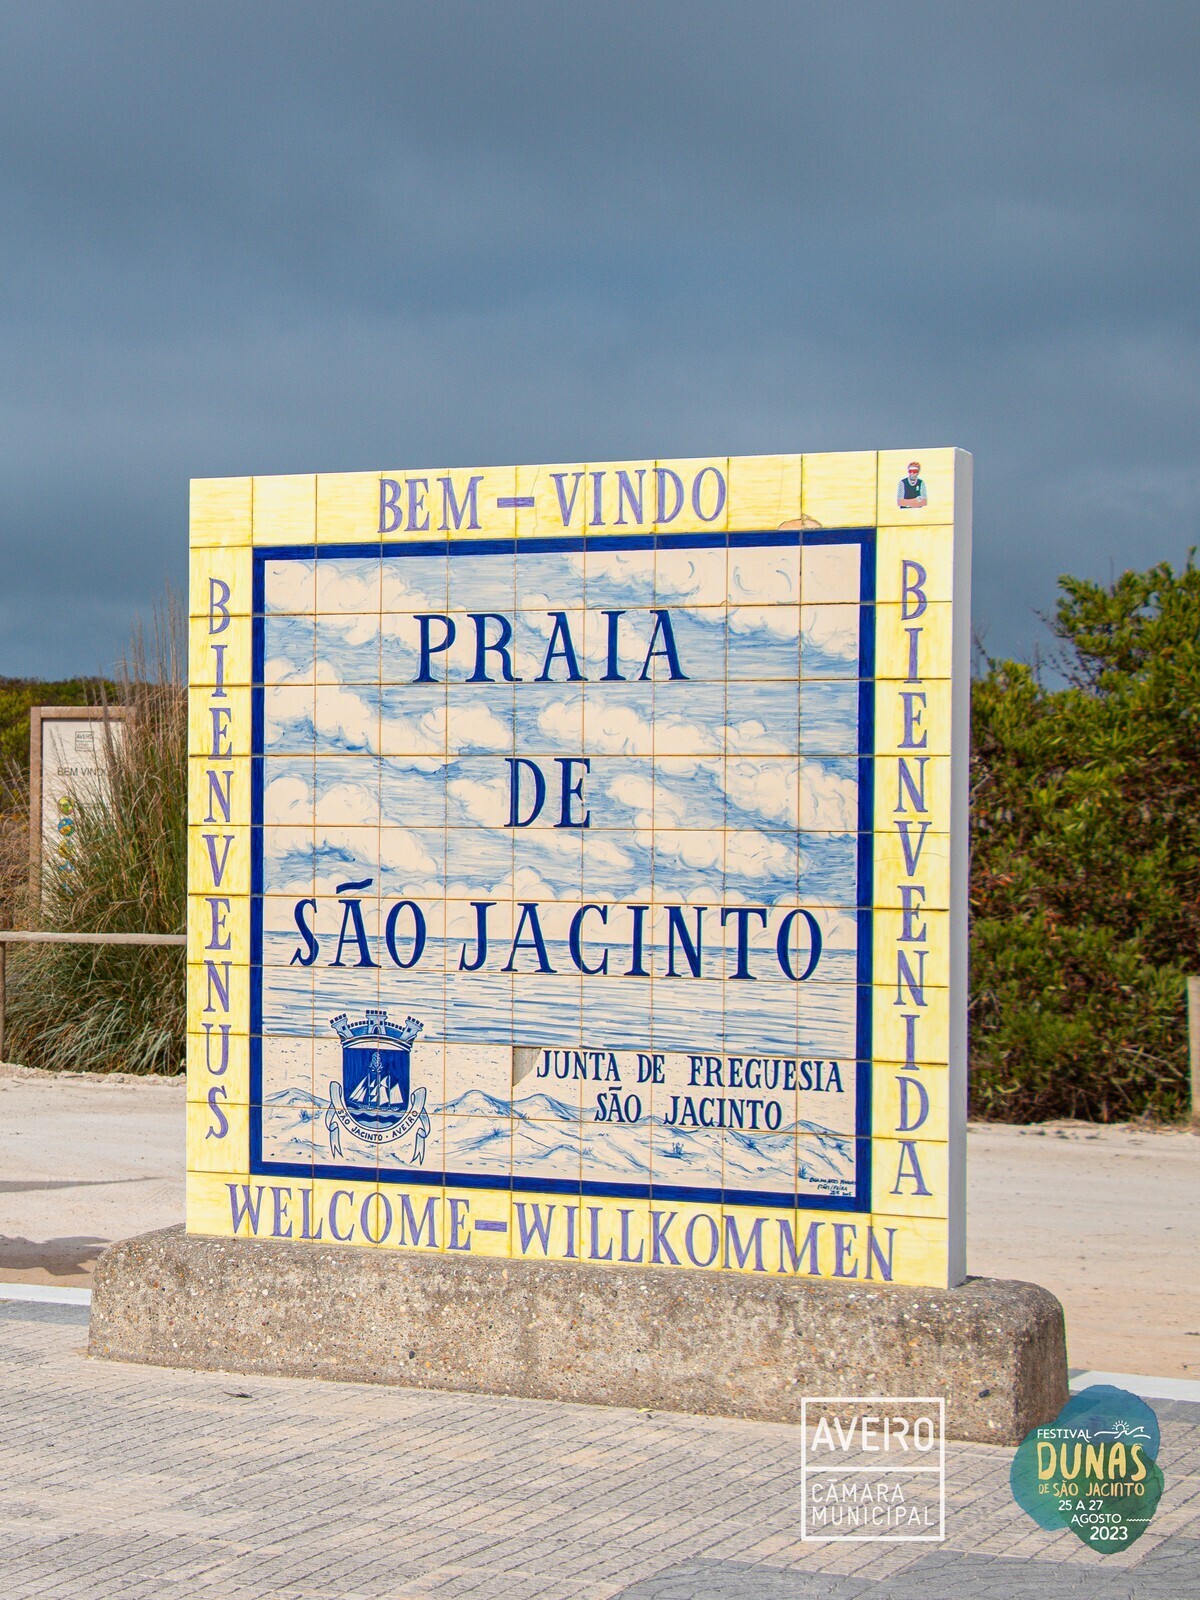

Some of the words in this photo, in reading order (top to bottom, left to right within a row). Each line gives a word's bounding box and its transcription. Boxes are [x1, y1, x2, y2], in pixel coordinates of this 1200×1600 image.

[414, 609, 691, 683] PRAIA
[504, 757, 593, 829] DE
[202, 578, 234, 1140] BIENVENUS
[891, 559, 933, 1196] BIENVENIDA
[290, 877, 428, 970] SÃO
[458, 900, 824, 983] JACINTO
[536, 1050, 622, 1082] JUNTA
[636, 1053, 666, 1084] DE
[687, 1055, 845, 1093] FREGUESIA
[593, 1085, 642, 1124] SÃO
[662, 1095, 783, 1131] JACINTO
[337, 1109, 351, 1125] SÃO
[351, 1125, 383, 1142] JACINTO
[391, 1109, 419, 1138] AVEIRO
